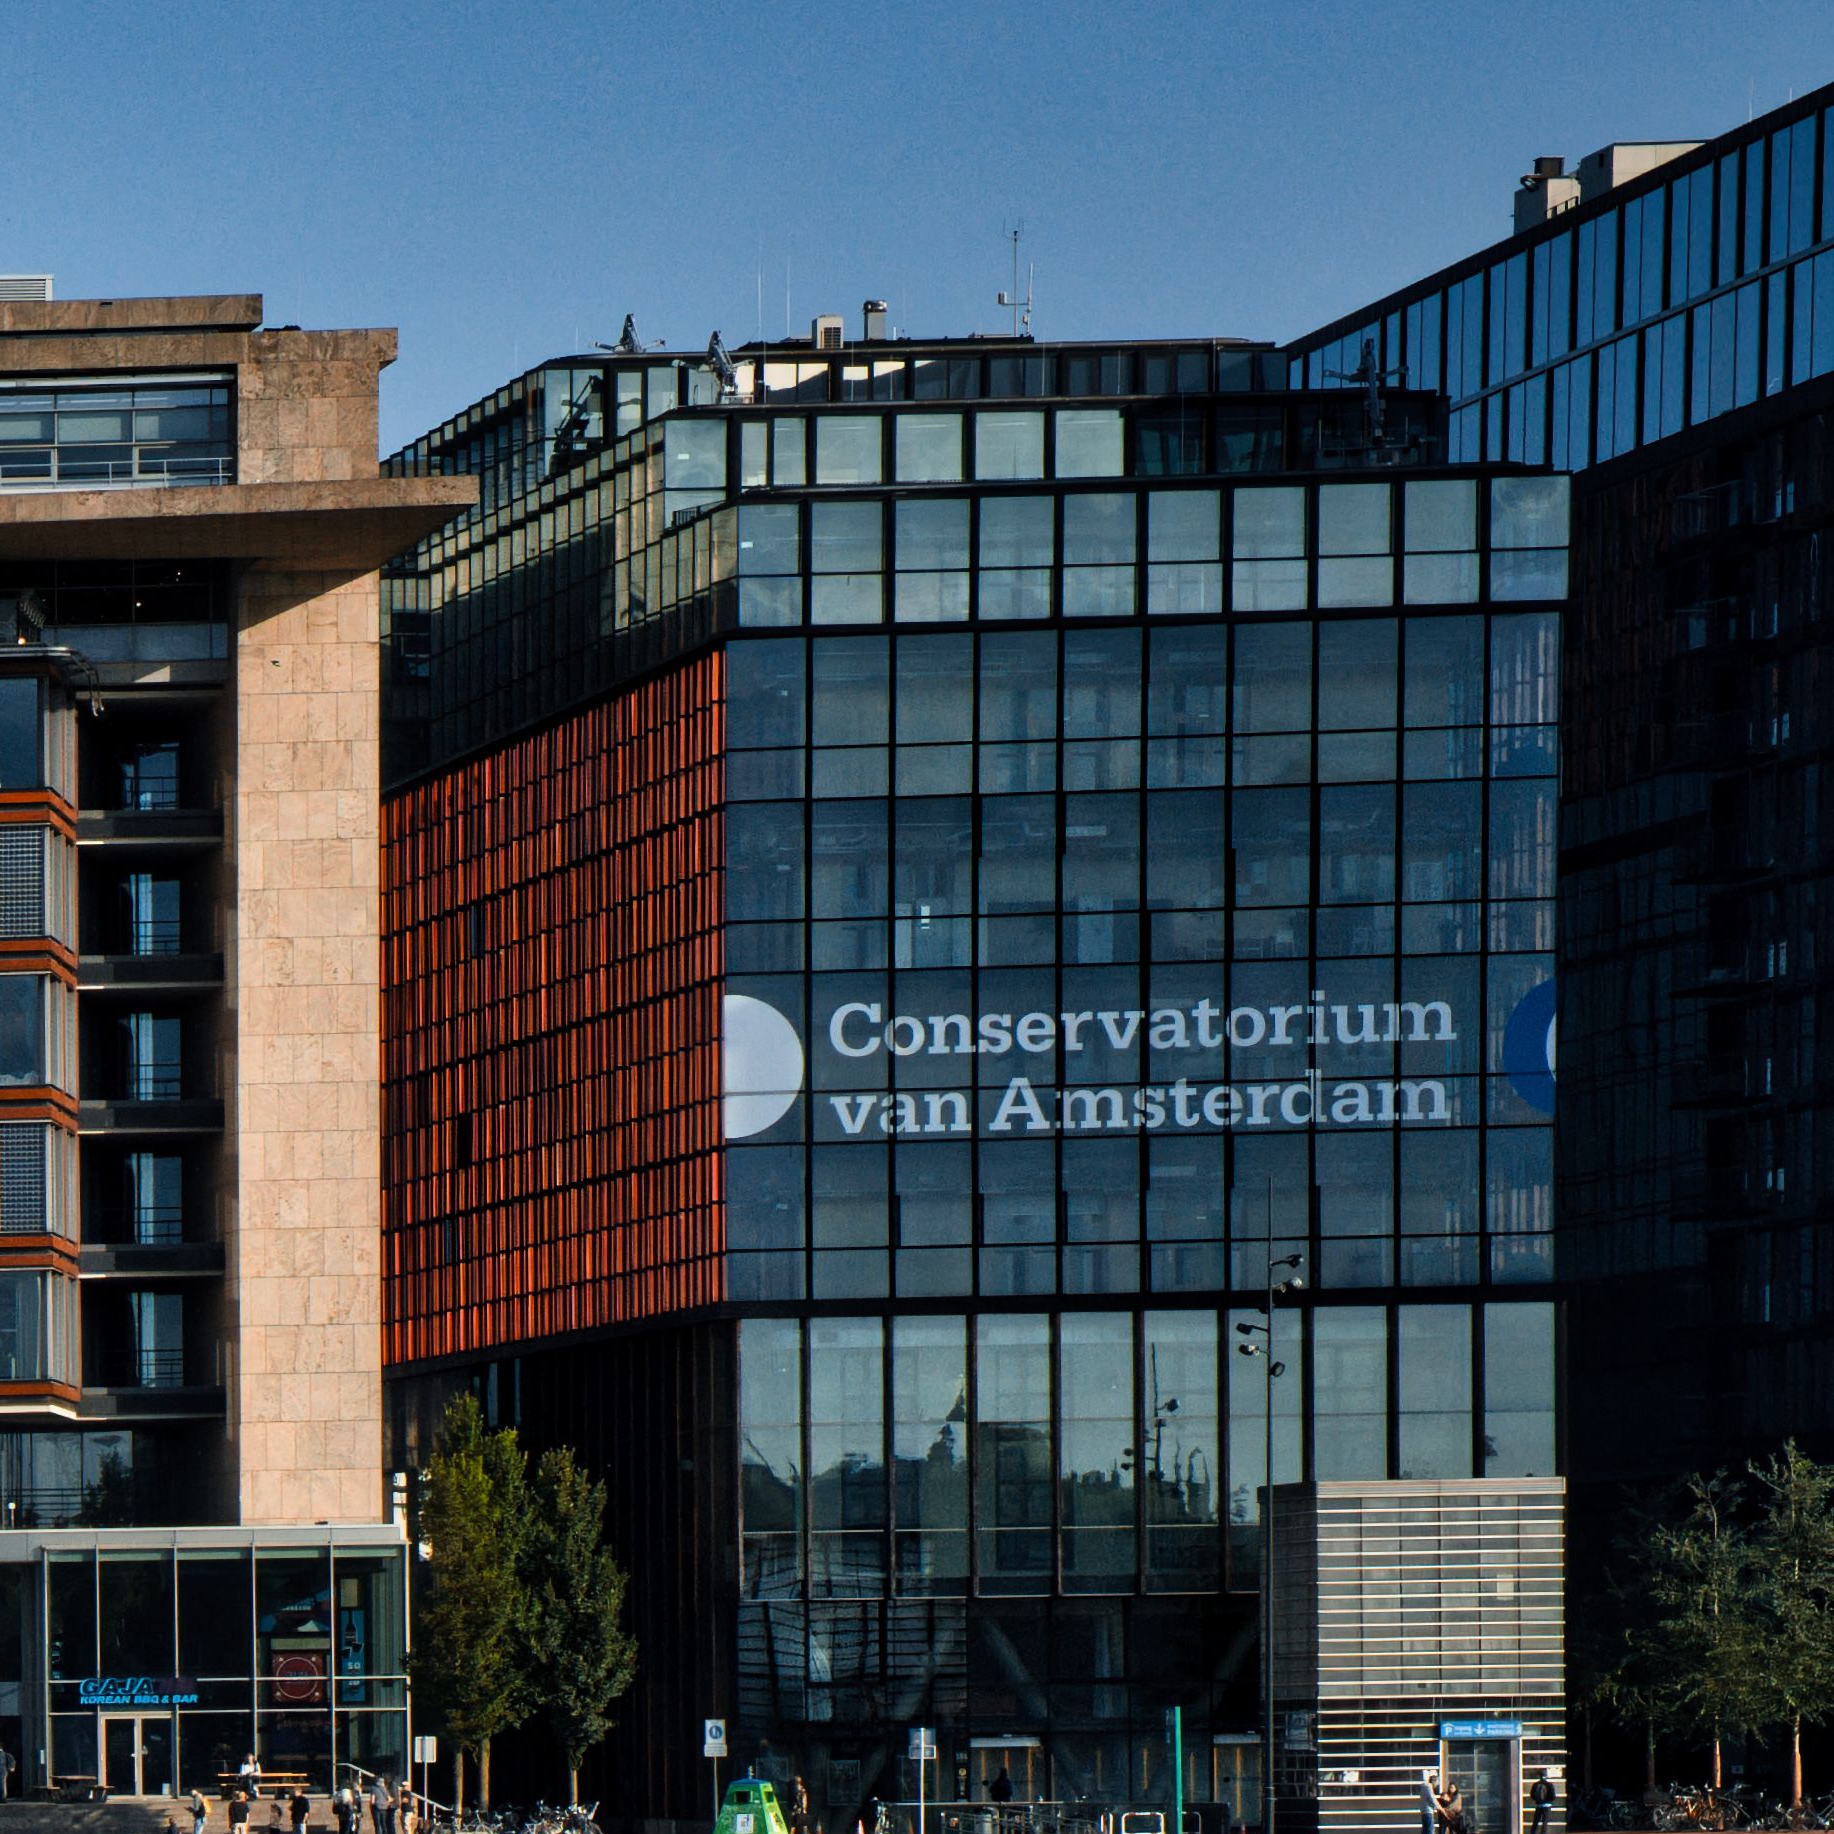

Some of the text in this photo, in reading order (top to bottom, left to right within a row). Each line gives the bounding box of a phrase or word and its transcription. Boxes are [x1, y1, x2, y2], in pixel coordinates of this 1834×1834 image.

[830, 989, 1457, 1057] Conservatorium
[830, 1068, 1451, 1135] van Amsterdam
[79, 1677, 154, 1695] GAJA
[80, 1694, 199, 1704] KOREAN BBQ & BAR
